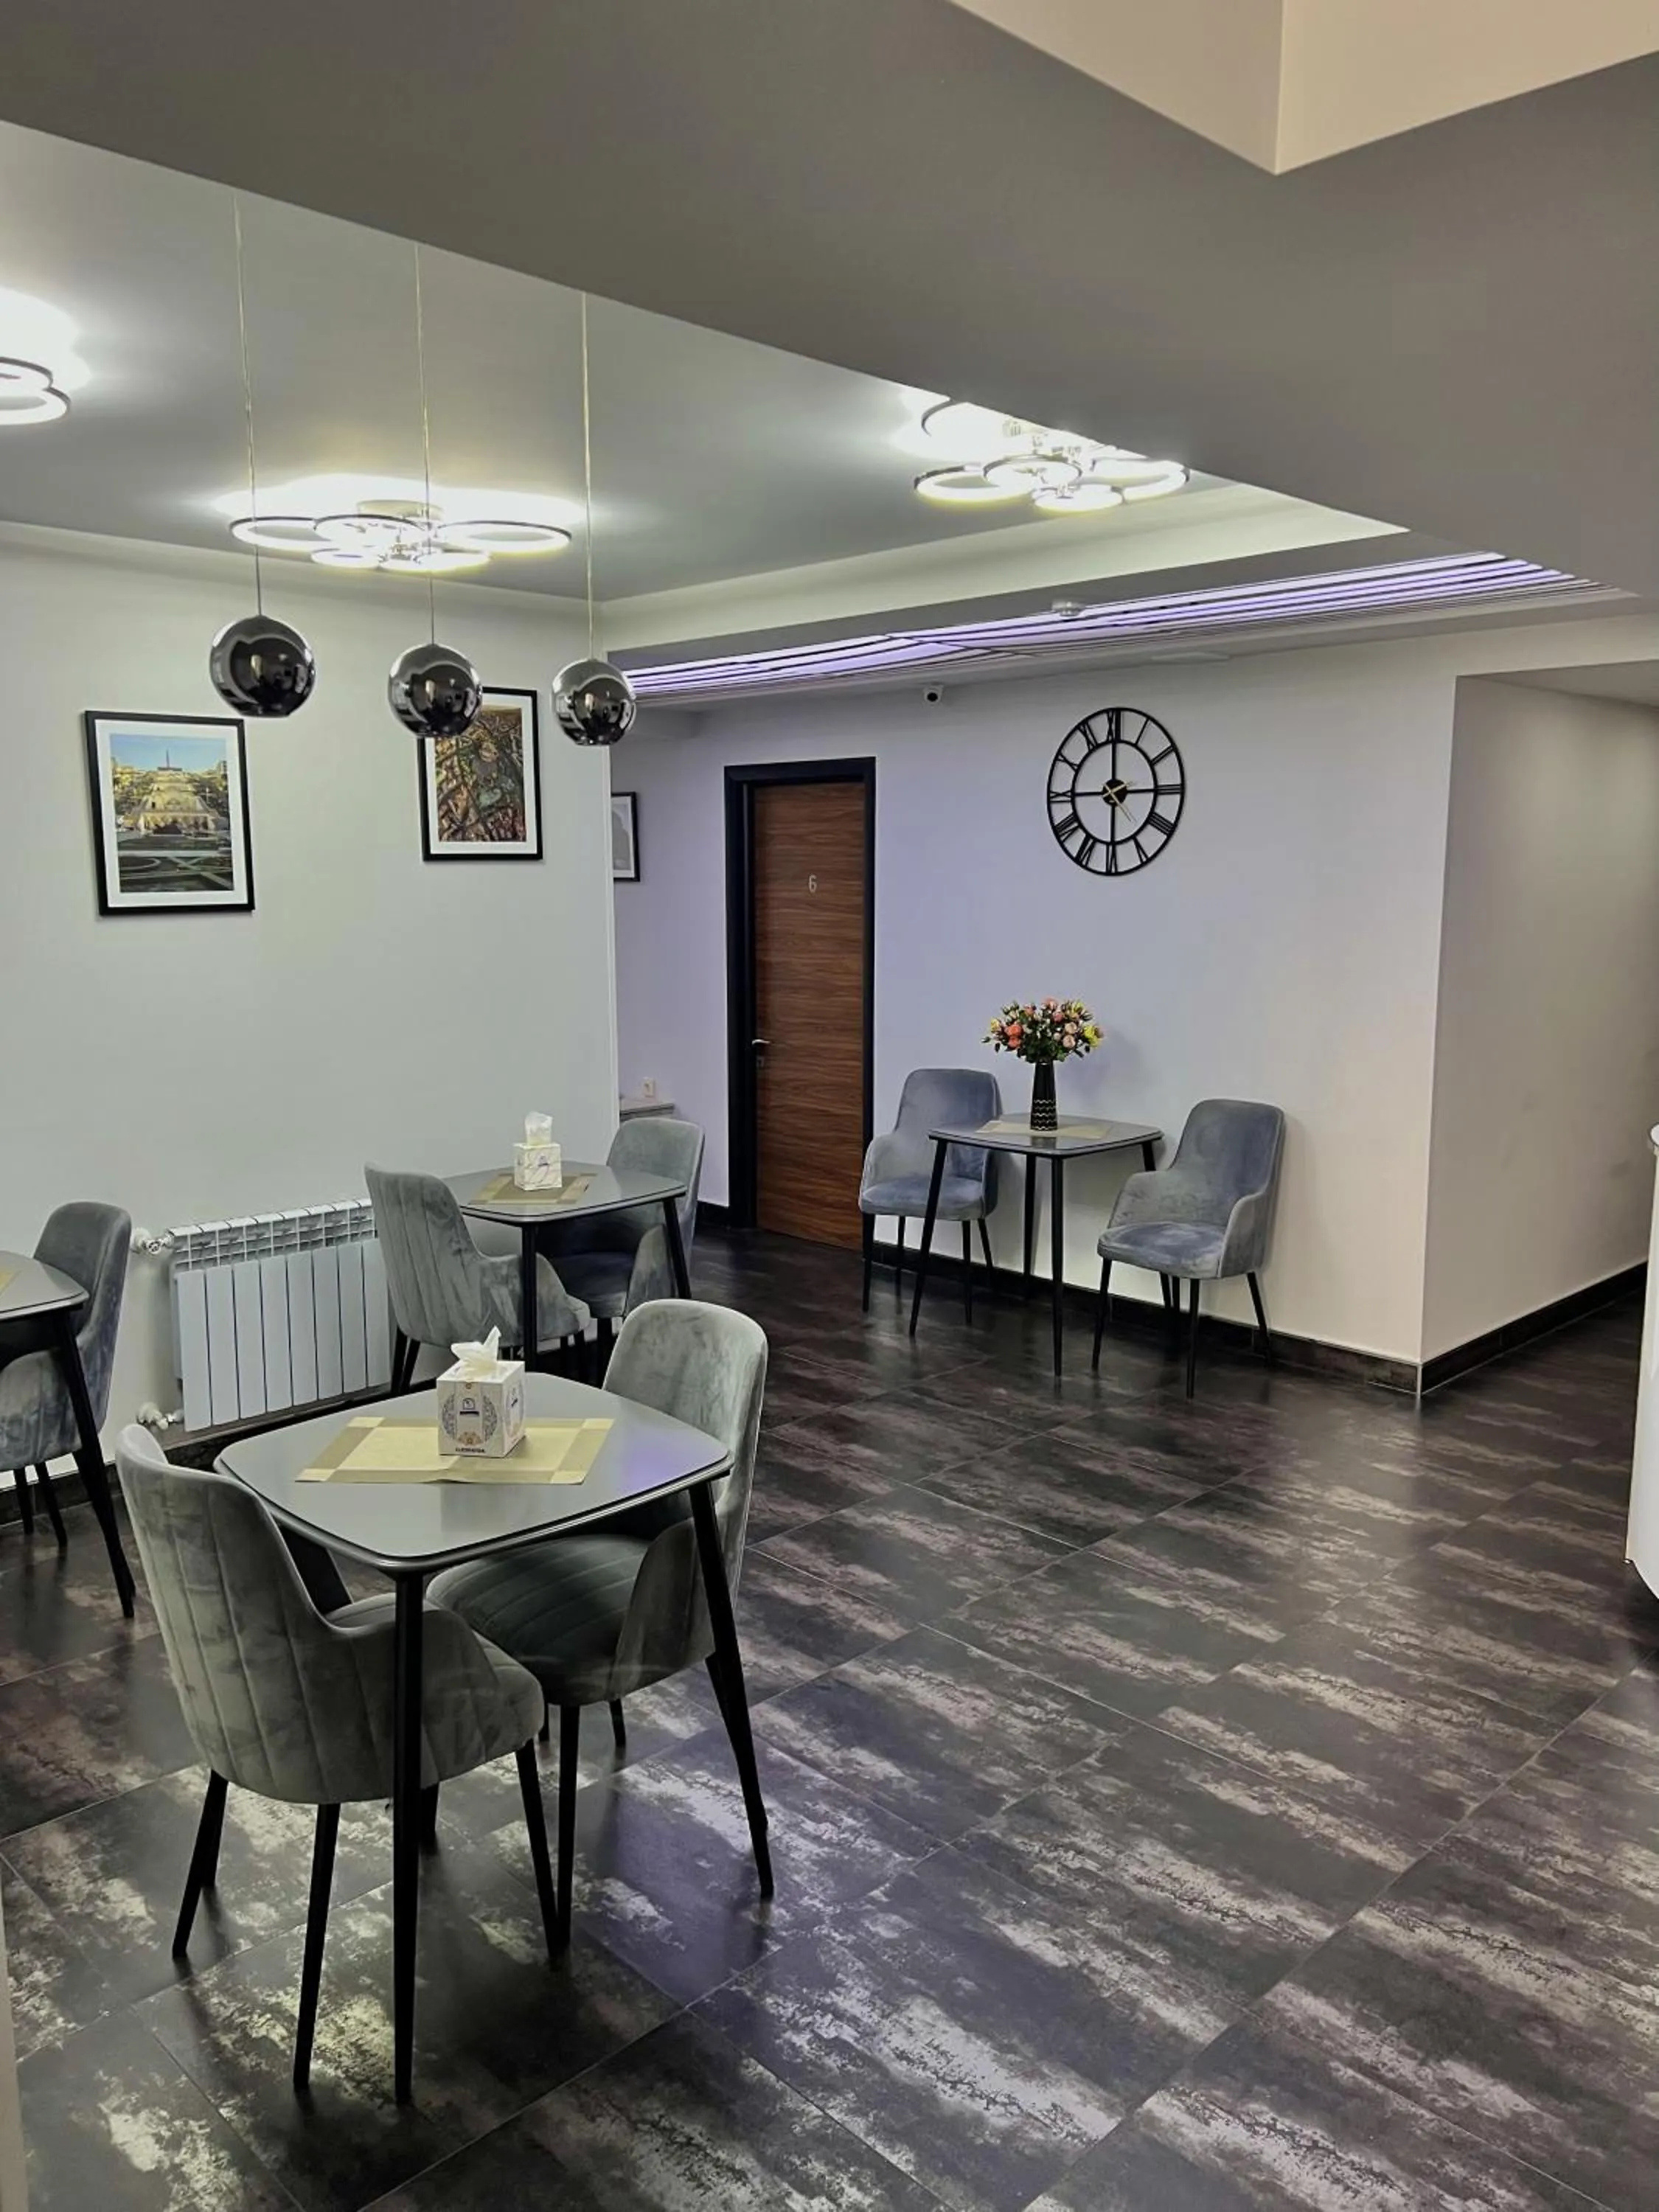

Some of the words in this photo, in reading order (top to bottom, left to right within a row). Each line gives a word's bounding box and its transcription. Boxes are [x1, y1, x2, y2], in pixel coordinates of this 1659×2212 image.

[1157, 784, 1181, 794] III
[1133, 836, 1149, 863] V
[808, 874, 818, 894] 6
